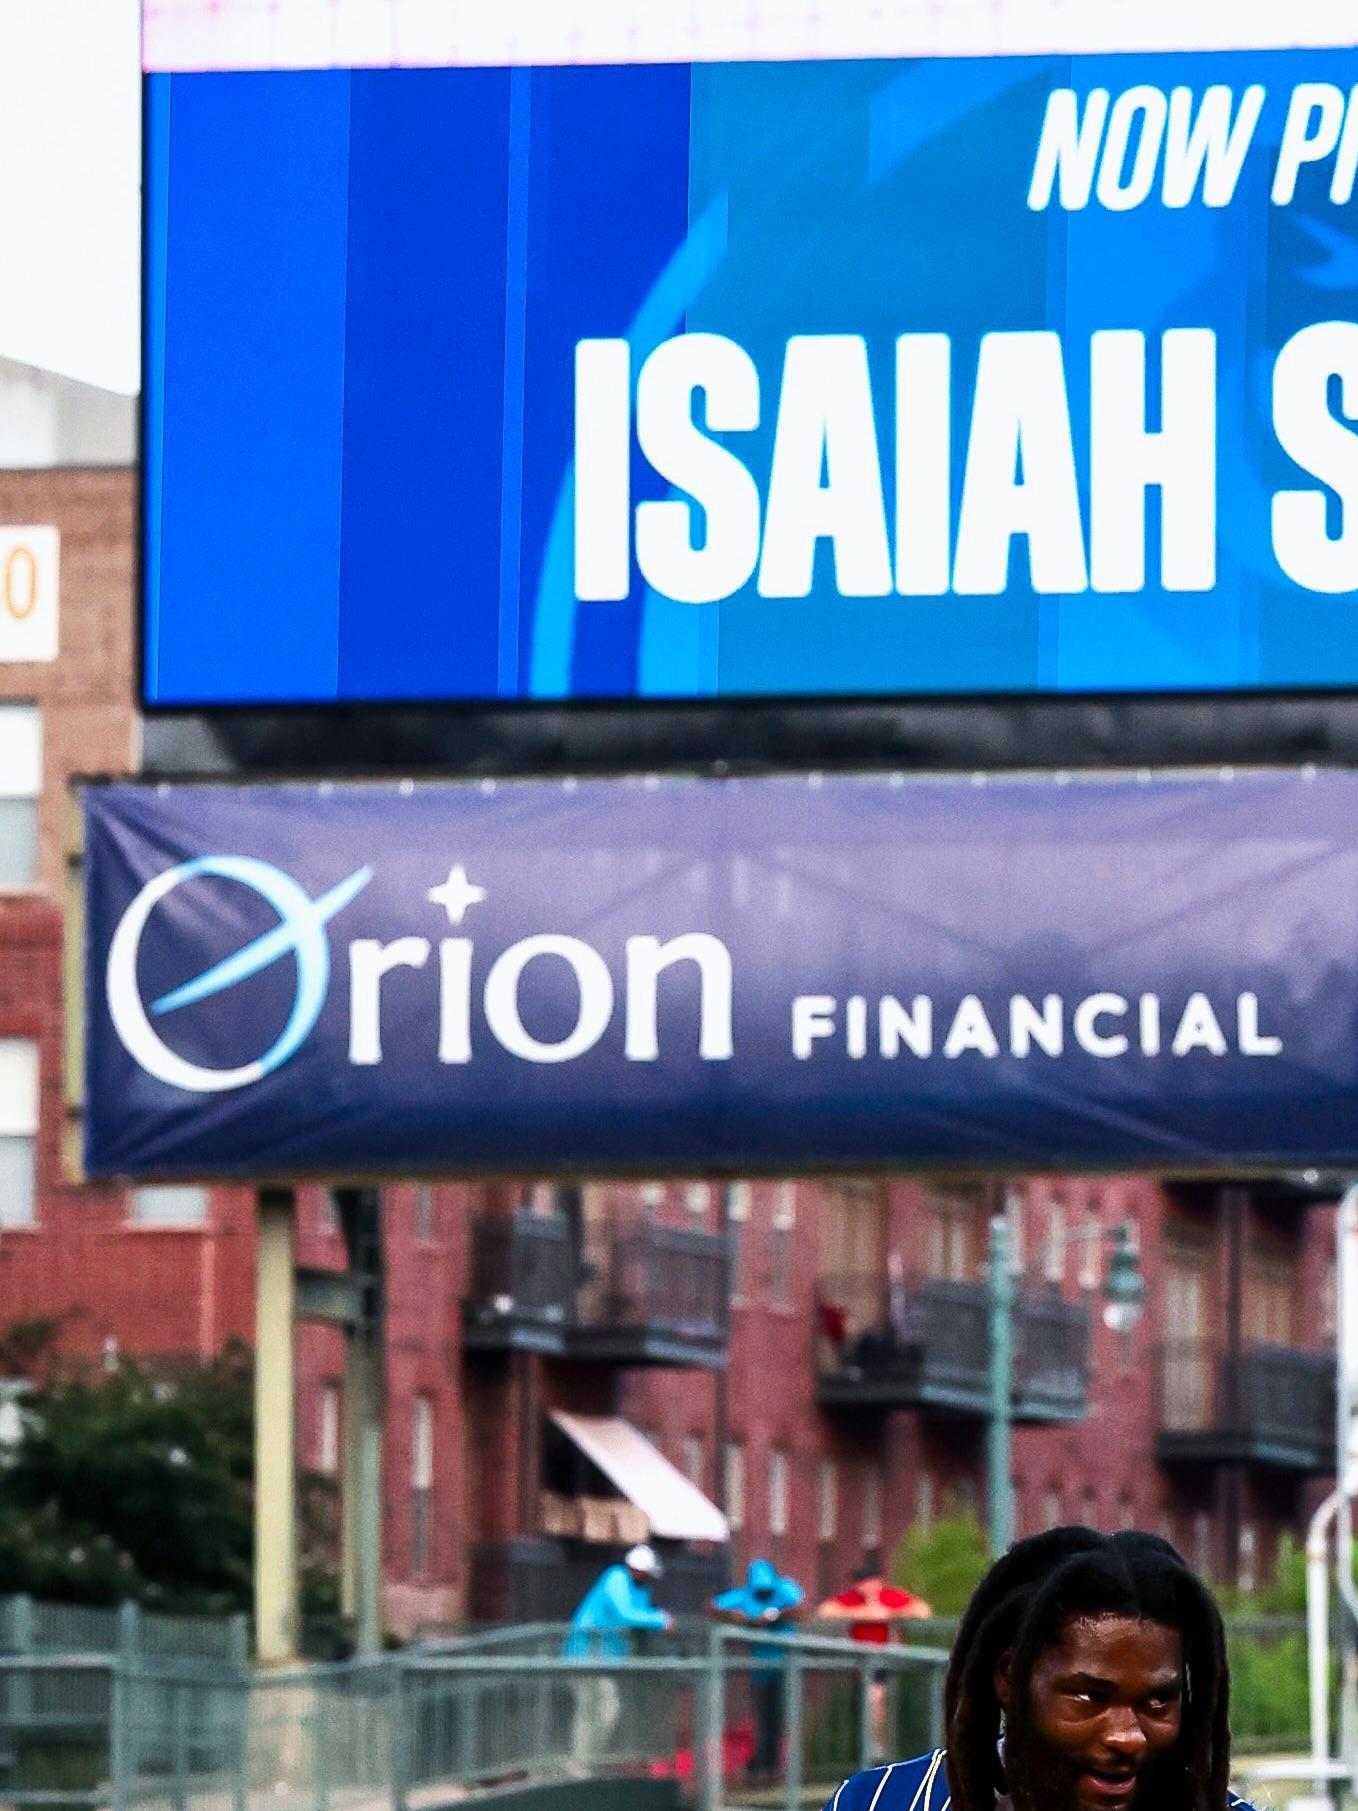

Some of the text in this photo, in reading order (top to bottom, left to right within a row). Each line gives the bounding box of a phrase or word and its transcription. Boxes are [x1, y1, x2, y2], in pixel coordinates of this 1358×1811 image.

[1027, 83, 1266, 212] NOW
[574, 328, 1217, 605] ISAIAH
[106, 856, 1283, 1093] Orion FINANCIAL
